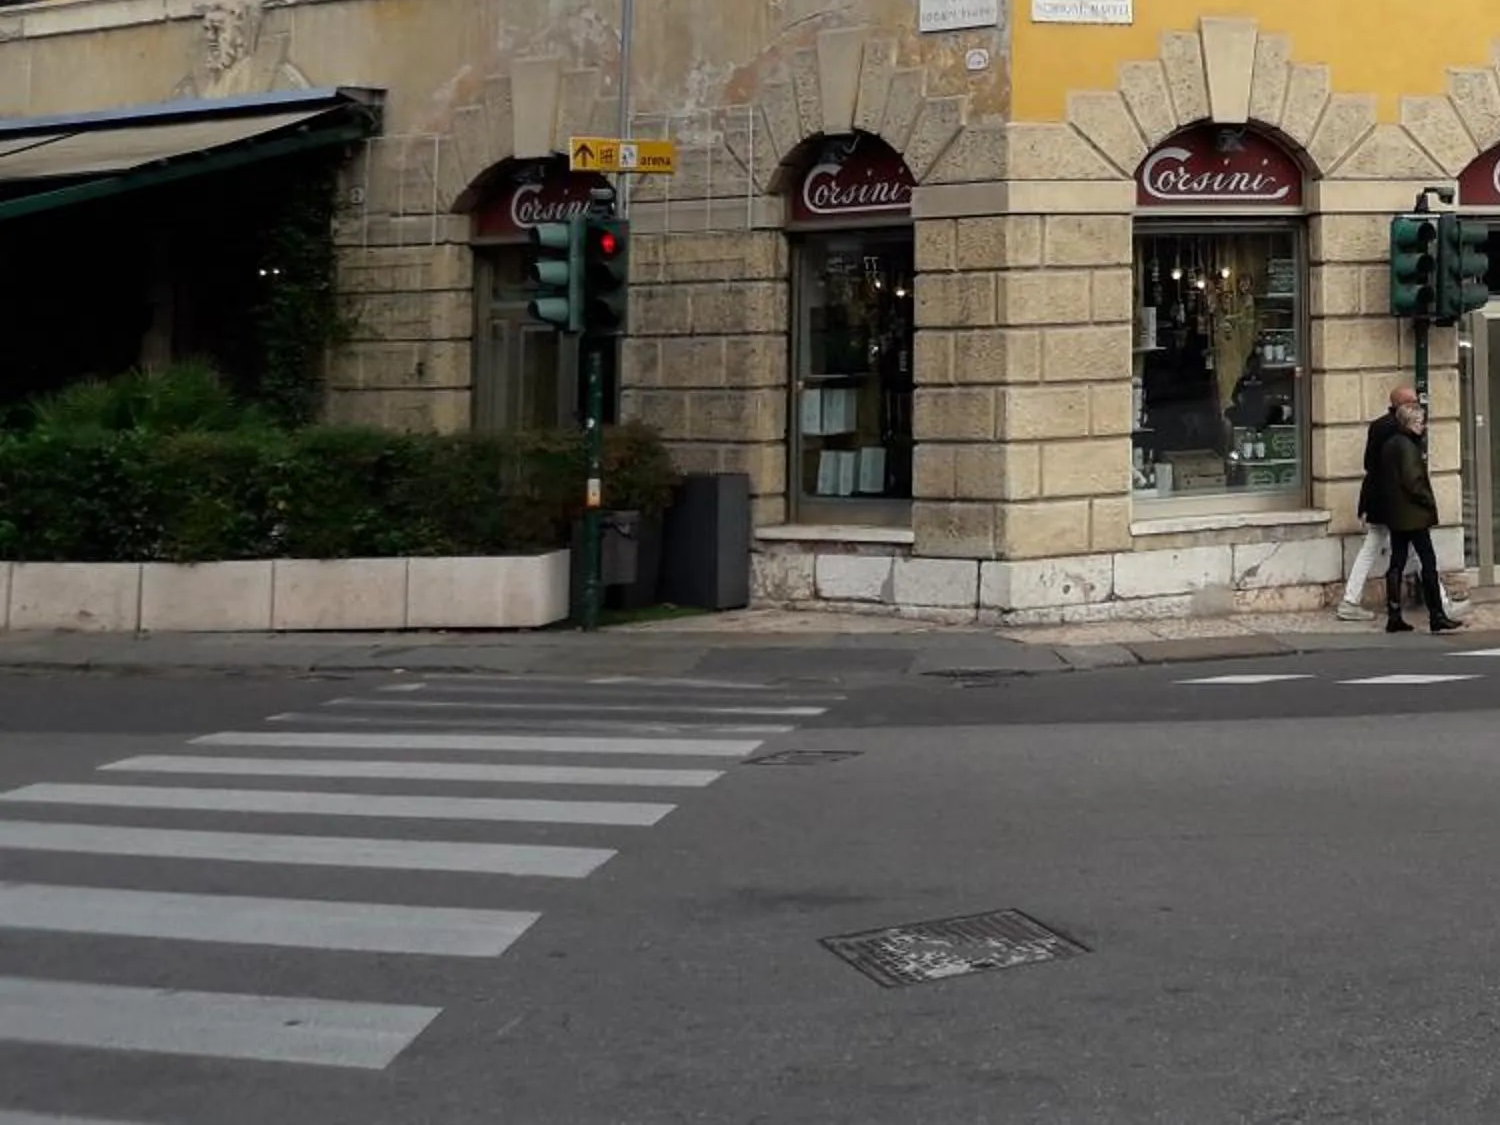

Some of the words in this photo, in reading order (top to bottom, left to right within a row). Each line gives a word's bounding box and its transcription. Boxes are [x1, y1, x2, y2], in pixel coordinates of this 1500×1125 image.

[639, 153, 672, 166] arena
[1143, 146, 1291, 200] Corsini
[803, 162, 912, 214] Corsini
